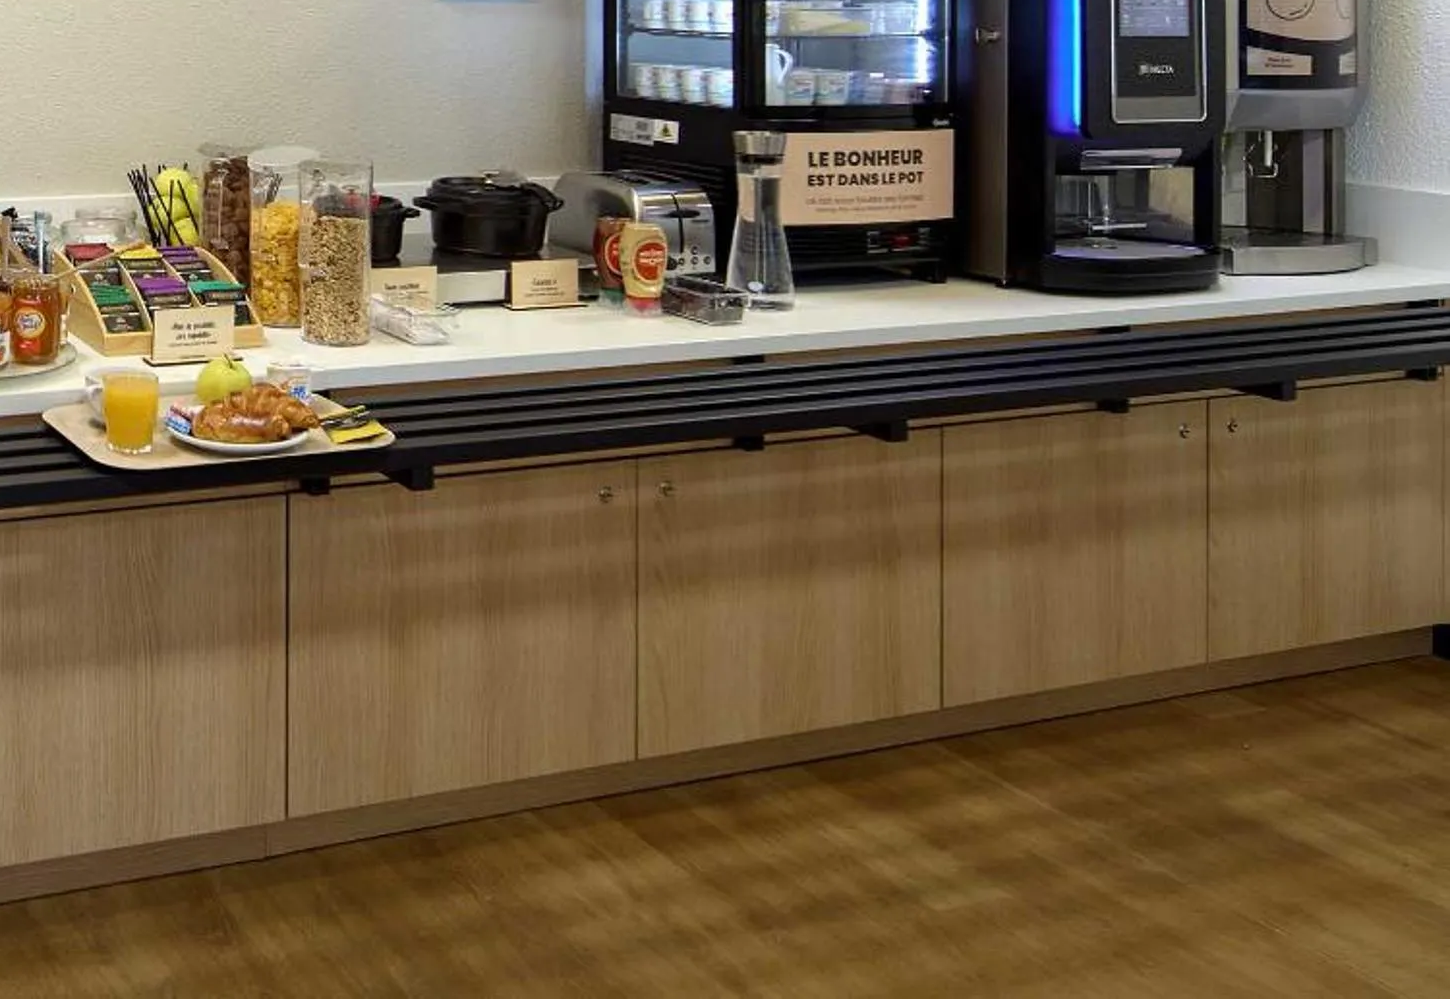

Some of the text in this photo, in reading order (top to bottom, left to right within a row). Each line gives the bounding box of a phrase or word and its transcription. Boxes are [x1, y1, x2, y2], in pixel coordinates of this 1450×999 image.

[808, 149, 923, 168] LE BONHEUR
[807, 171, 924, 187] EST DANS LE POT
